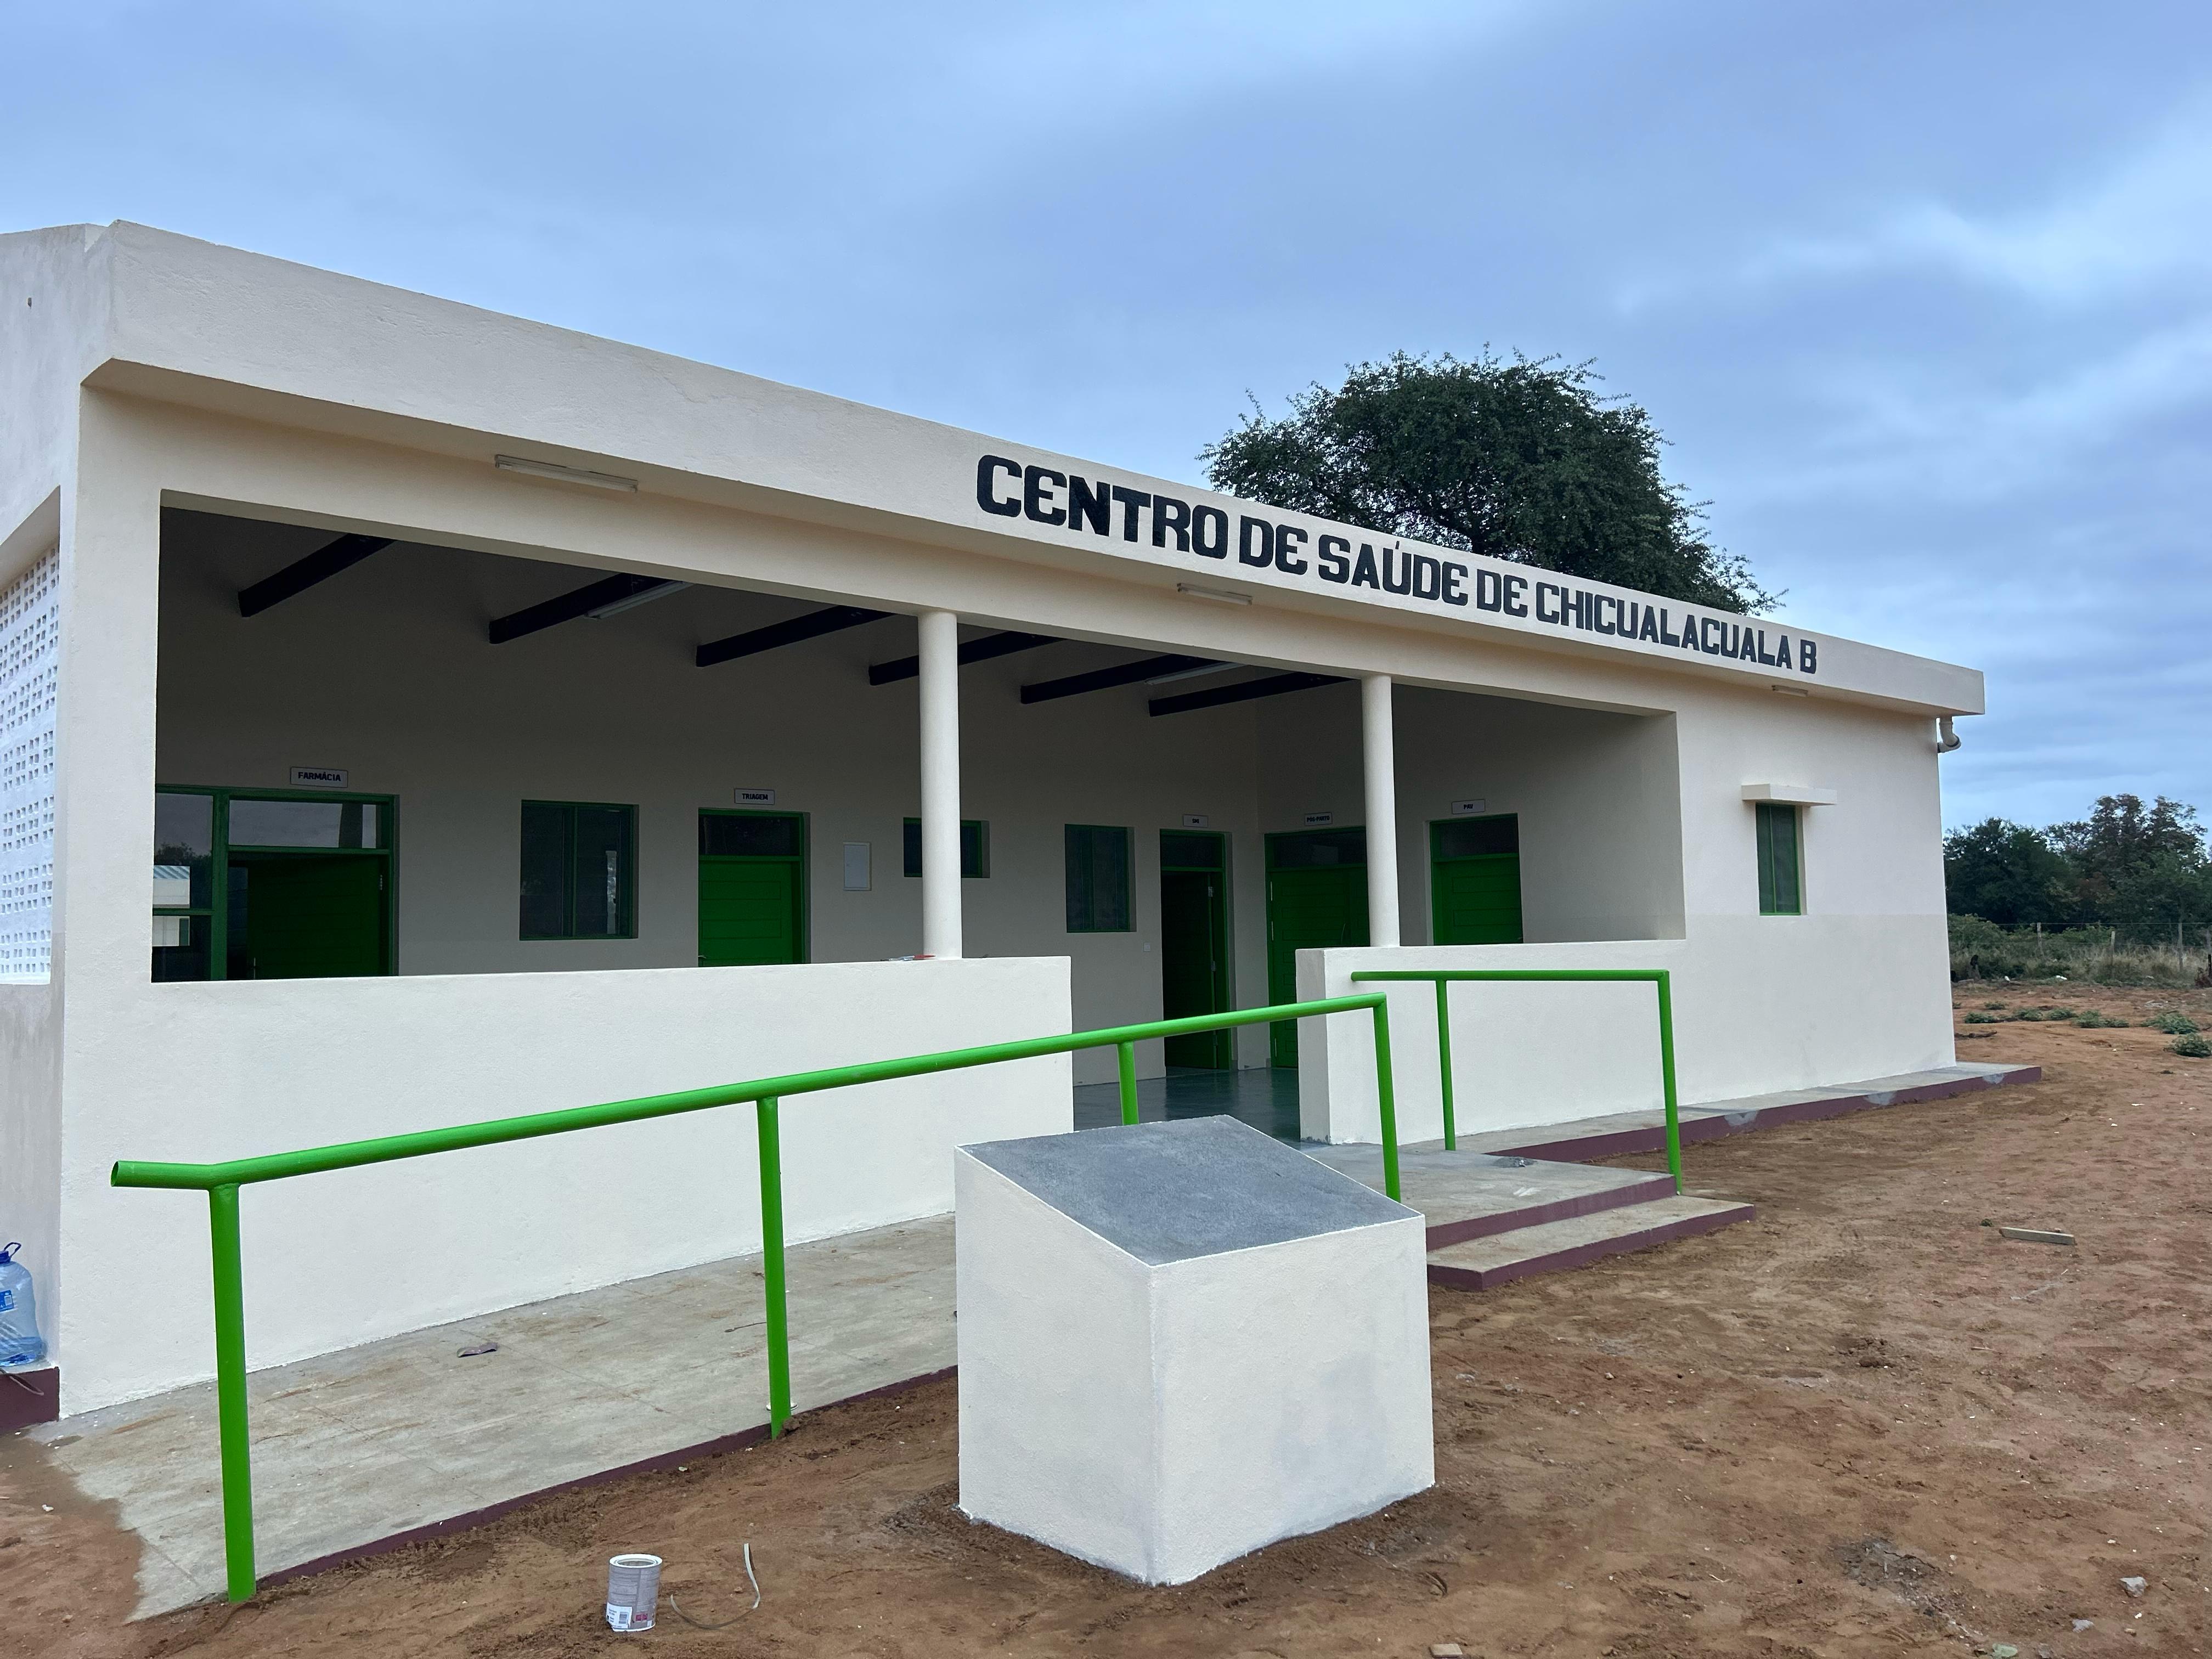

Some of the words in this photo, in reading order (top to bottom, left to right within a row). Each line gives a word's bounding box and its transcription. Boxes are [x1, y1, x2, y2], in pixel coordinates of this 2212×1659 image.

[977, 454, 1229, 560] CENTRO
[1239, 515, 1308, 575] DE
[1318, 534, 1469, 606] SAÚDE
[1476, 568, 1528, 618] DE
[1536, 582, 1792, 670] CHICUALACUALA
[1800, 639, 1816, 674] B
[298, 771, 341, 782] FARMÁCIA
